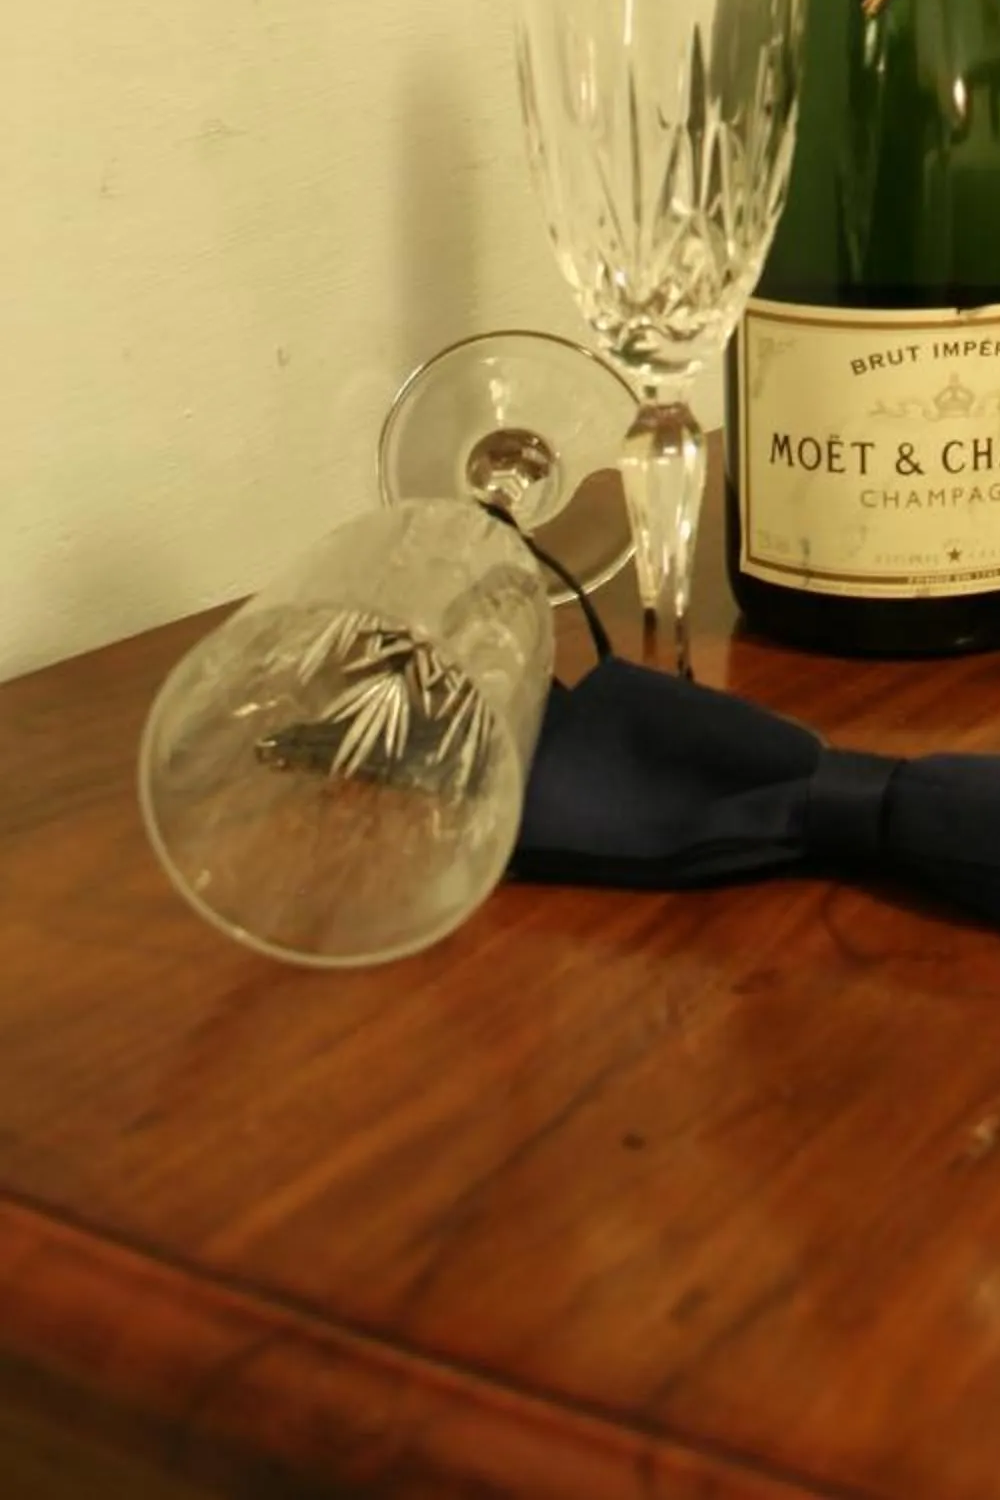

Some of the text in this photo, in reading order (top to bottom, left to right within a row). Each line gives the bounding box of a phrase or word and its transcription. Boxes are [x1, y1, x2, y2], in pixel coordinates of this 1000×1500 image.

[850, 344, 921, 377] BRUT
[769, 431, 876, 476] MOËT
[894, 441, 926, 477] &
